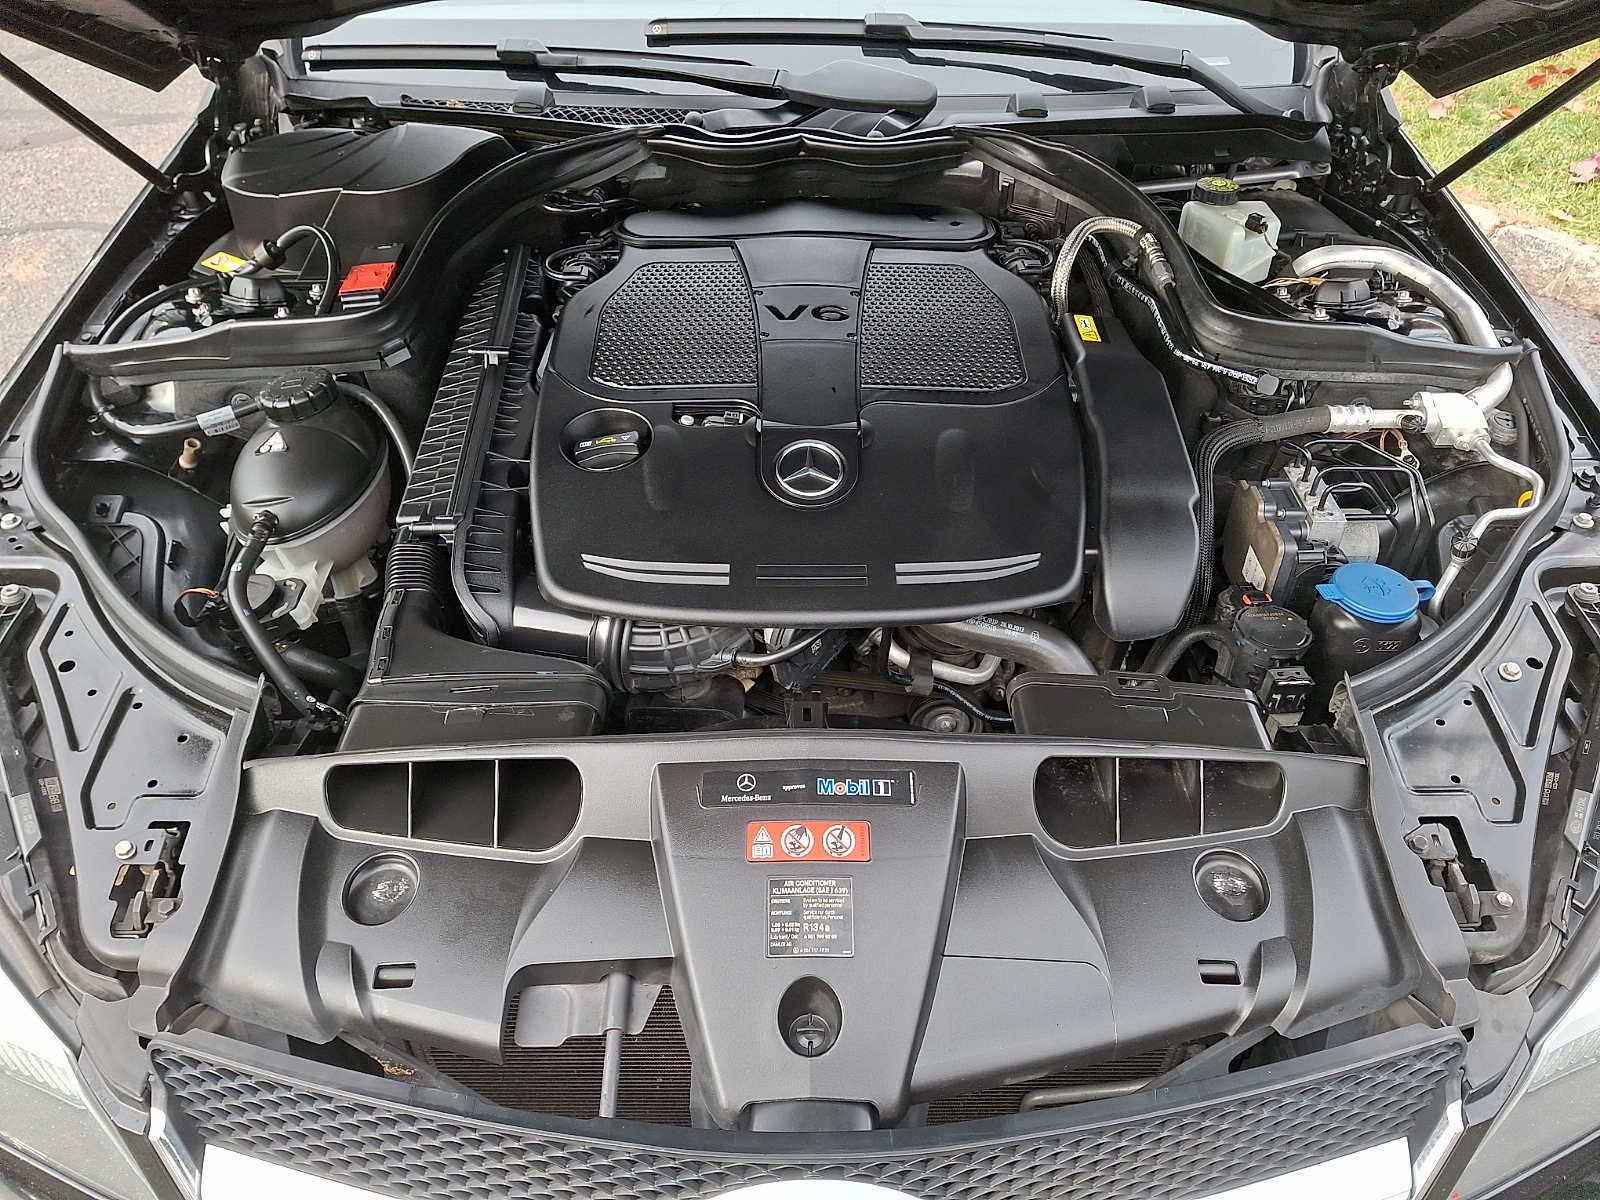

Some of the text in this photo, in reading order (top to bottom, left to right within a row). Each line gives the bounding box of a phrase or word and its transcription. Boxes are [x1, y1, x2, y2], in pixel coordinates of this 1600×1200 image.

[764, 304, 850, 321] V6
[817, 778, 870, 796] Mobil
[721, 794, 771, 802] Mercedes-Benz
